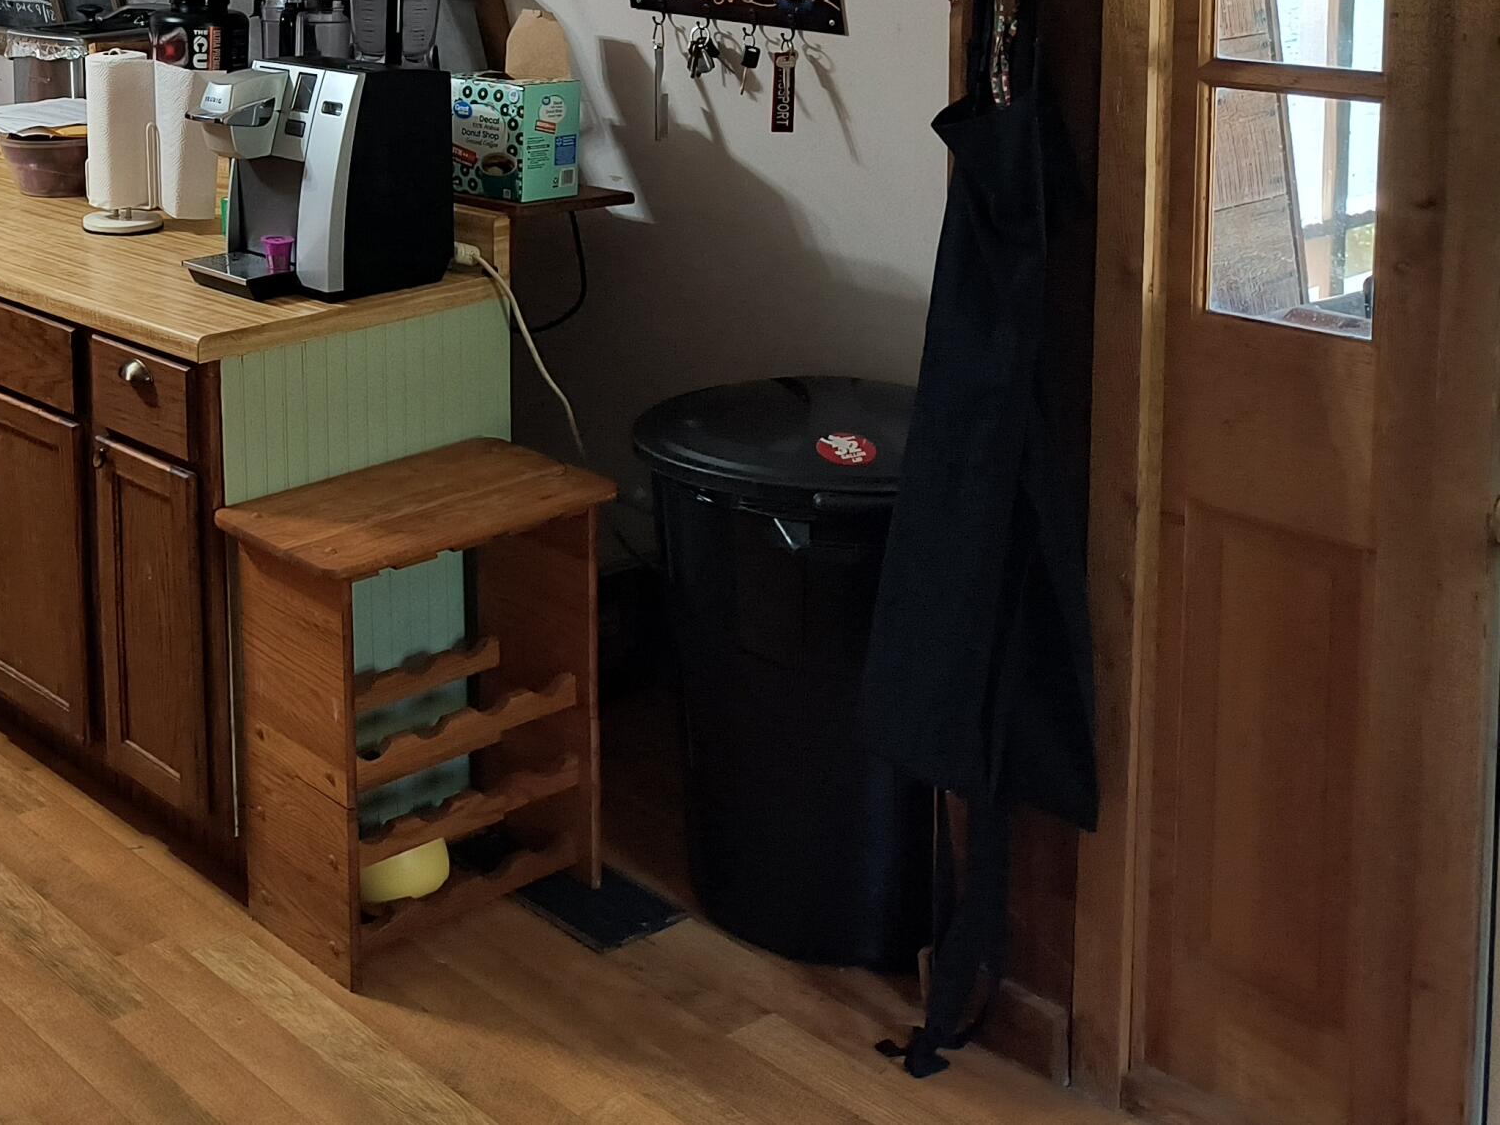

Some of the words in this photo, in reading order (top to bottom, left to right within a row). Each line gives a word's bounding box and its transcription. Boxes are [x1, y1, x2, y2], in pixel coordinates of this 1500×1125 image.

[479, 114, 500, 125] Decaf
[461, 127, 481, 138] Donut
[482, 130, 500, 141] Shop
